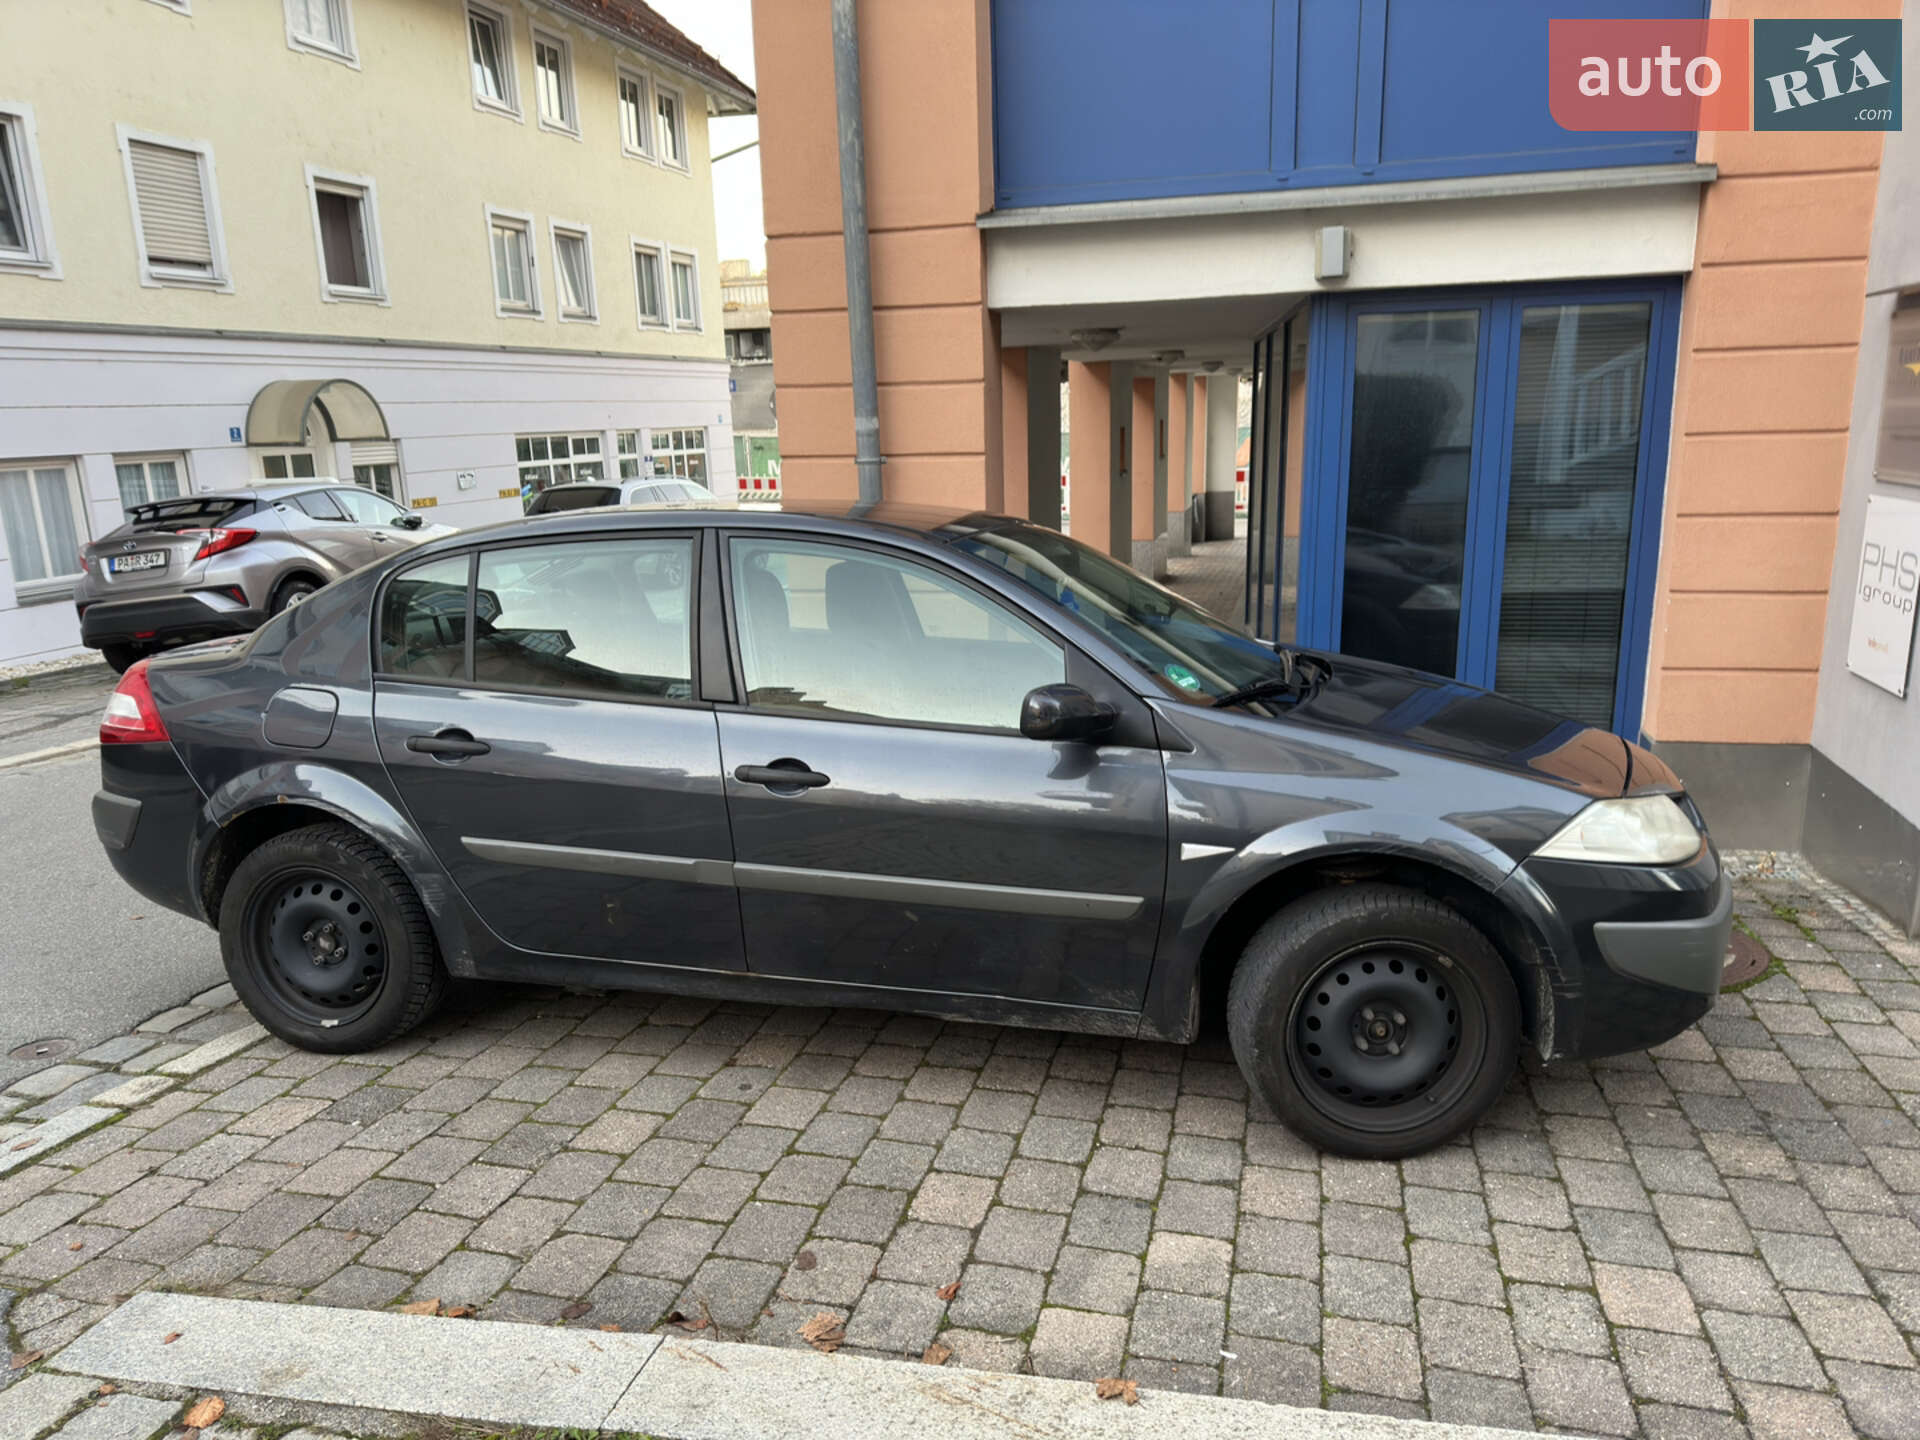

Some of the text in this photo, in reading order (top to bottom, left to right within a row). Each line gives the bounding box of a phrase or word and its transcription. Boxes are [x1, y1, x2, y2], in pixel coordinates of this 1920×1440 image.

[117, 553, 161, 569] PA R 347
[1858, 541, 1919, 594] PHS
[1862, 584, 1913, 616] group
